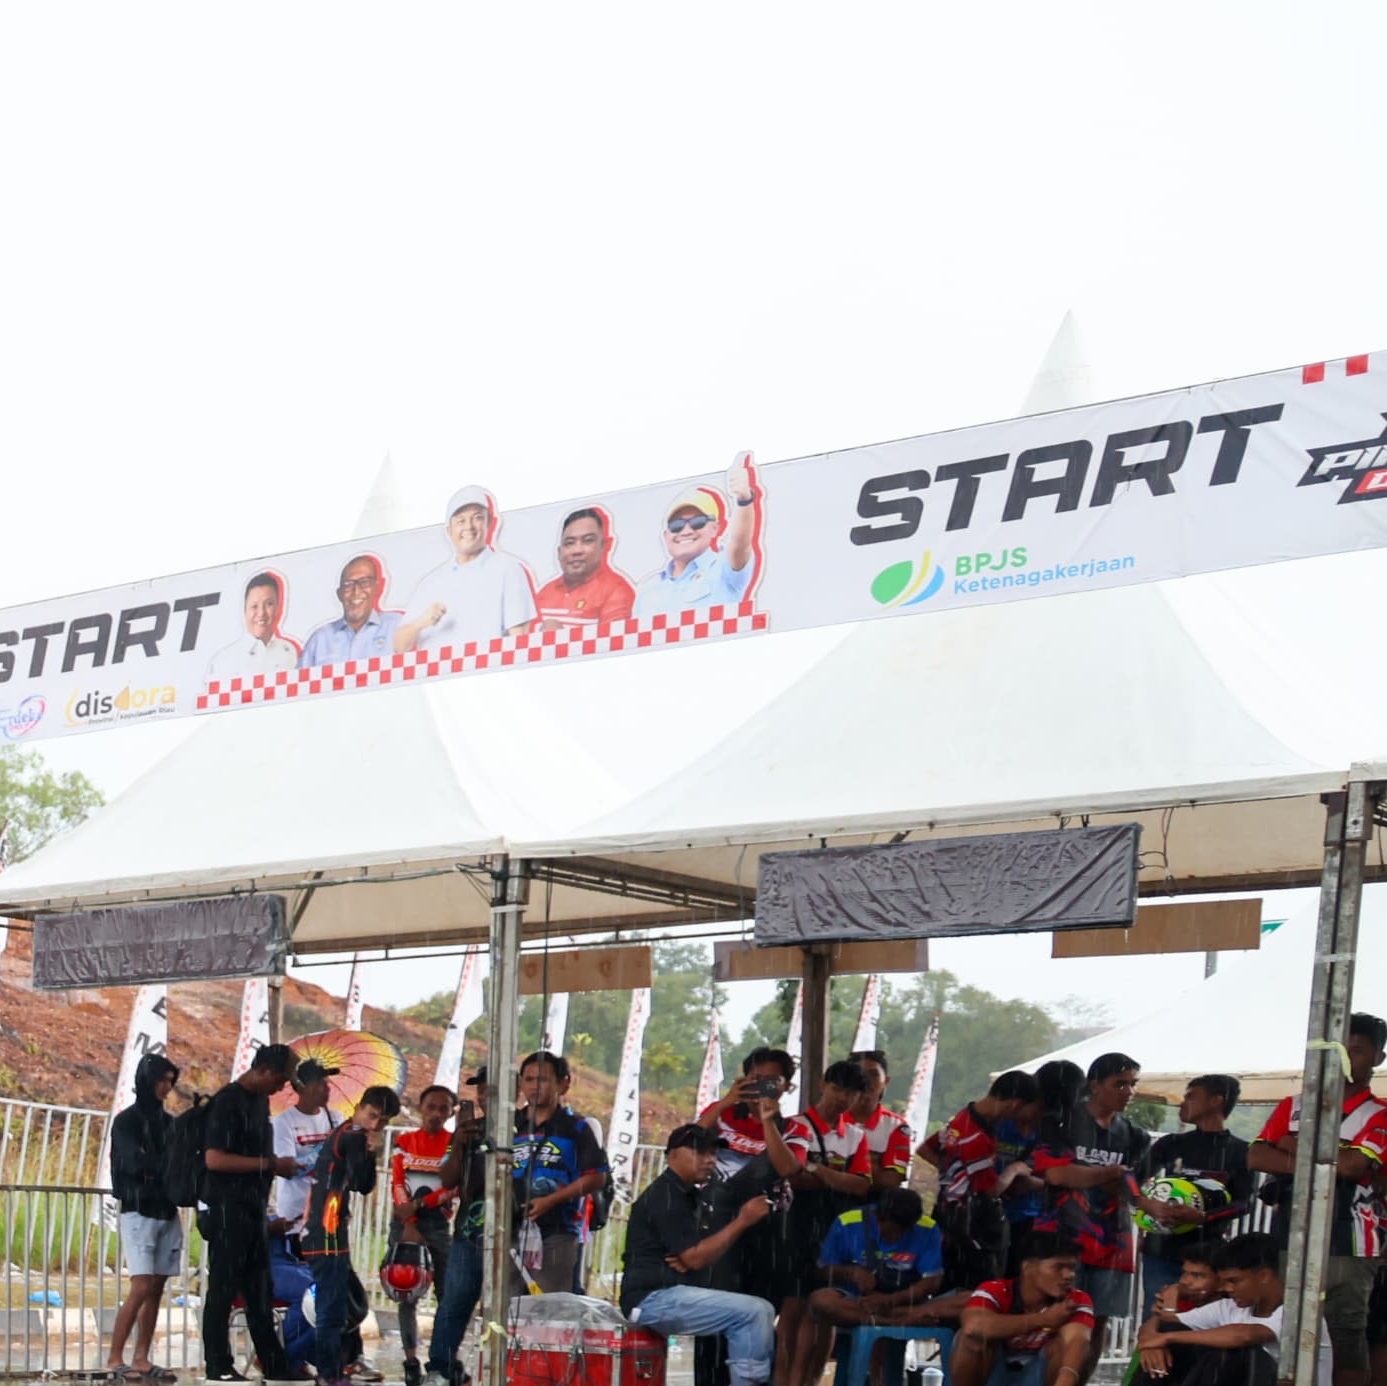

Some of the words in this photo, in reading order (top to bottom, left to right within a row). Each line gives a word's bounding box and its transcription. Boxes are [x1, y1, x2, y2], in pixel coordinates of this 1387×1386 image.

[849, 403, 1285, 546] START
[954, 555, 1136, 595] Ketenagakerjaan
[955, 547, 1027, 577] BPJS
